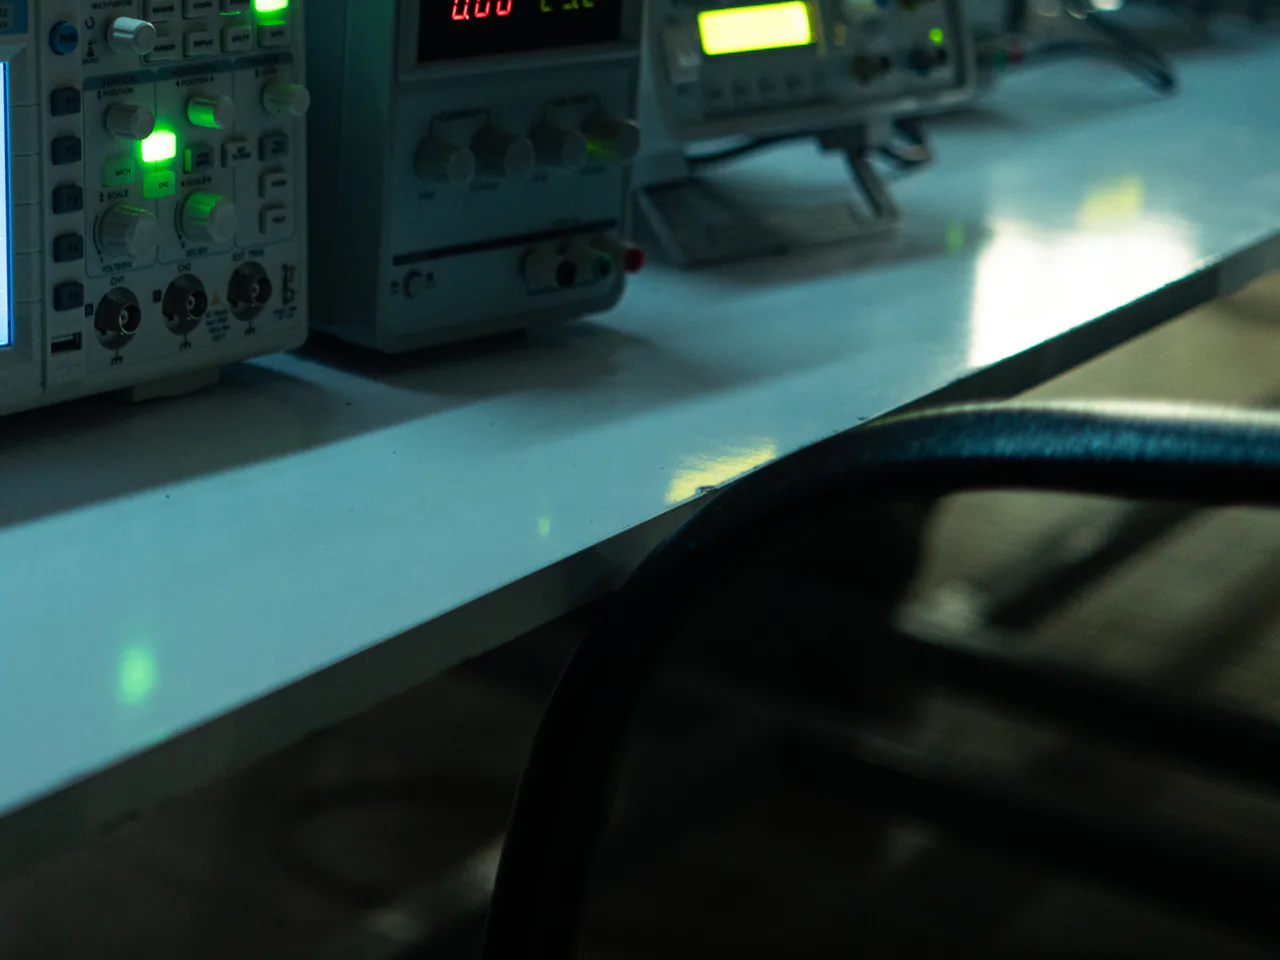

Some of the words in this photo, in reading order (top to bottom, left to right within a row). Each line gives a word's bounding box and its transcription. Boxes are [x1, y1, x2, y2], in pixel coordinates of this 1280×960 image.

[102, 87, 134, 98] POSITION
[115, 168, 132, 177] MATH
[107, 189, 129, 201] SCALE
[110, 276, 125, 287] CH1
